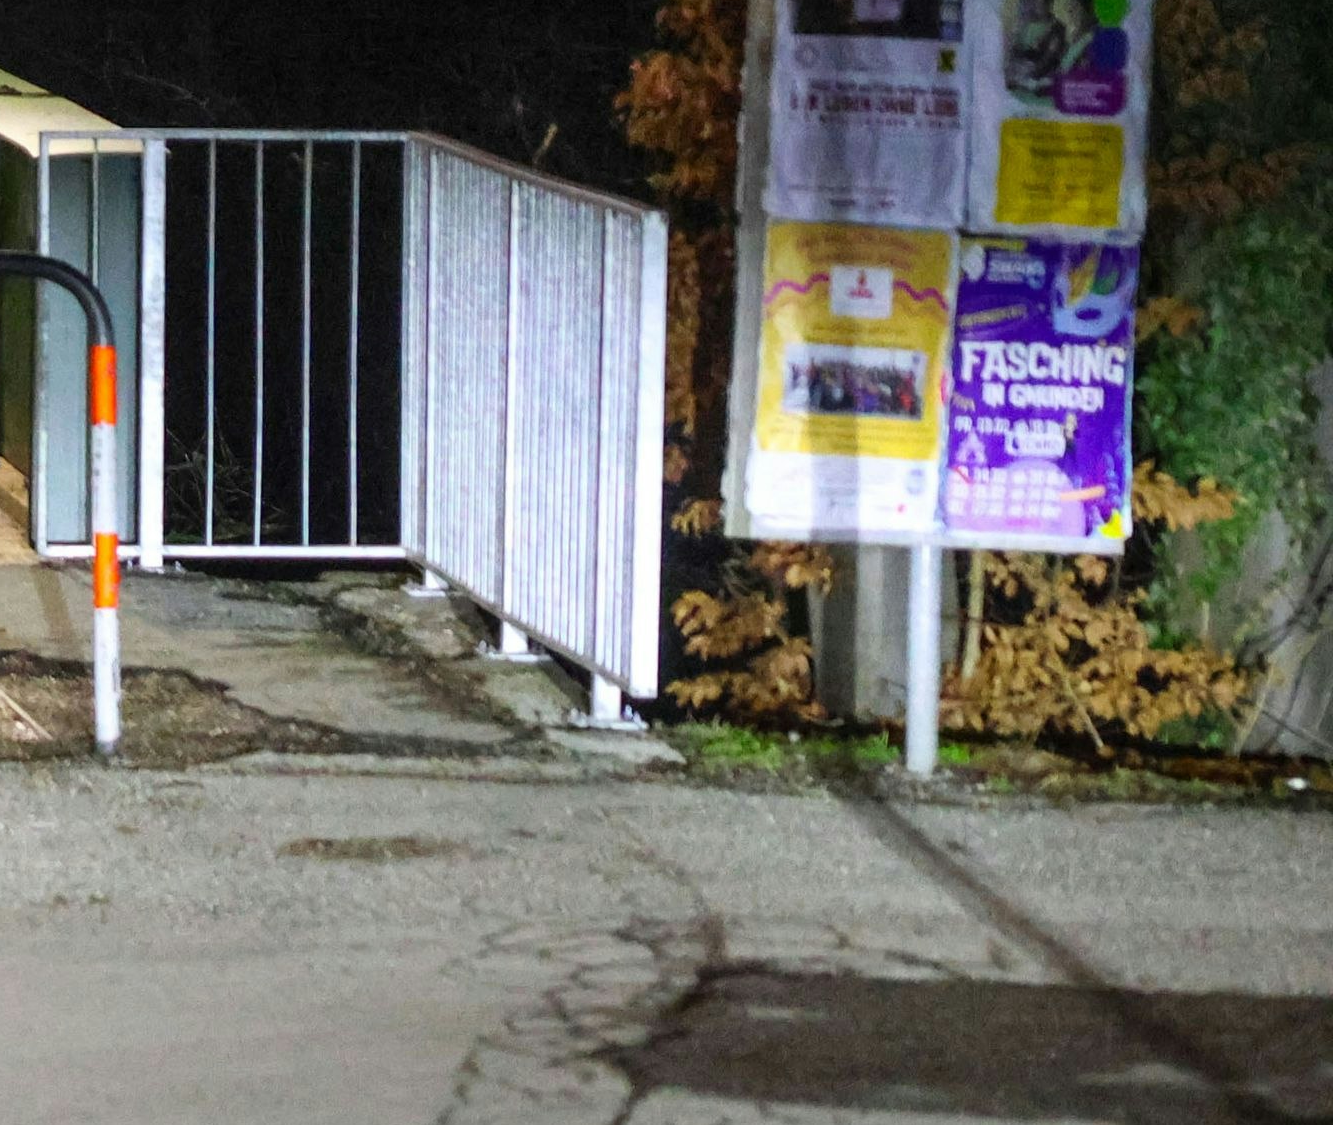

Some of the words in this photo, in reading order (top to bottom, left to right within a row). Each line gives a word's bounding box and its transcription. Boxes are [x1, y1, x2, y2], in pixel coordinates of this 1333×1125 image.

[959, 340, 1126, 386] FASCHING
[982, 382, 1006, 408] IN
[1008, 383, 1105, 413] GMUNDEN
